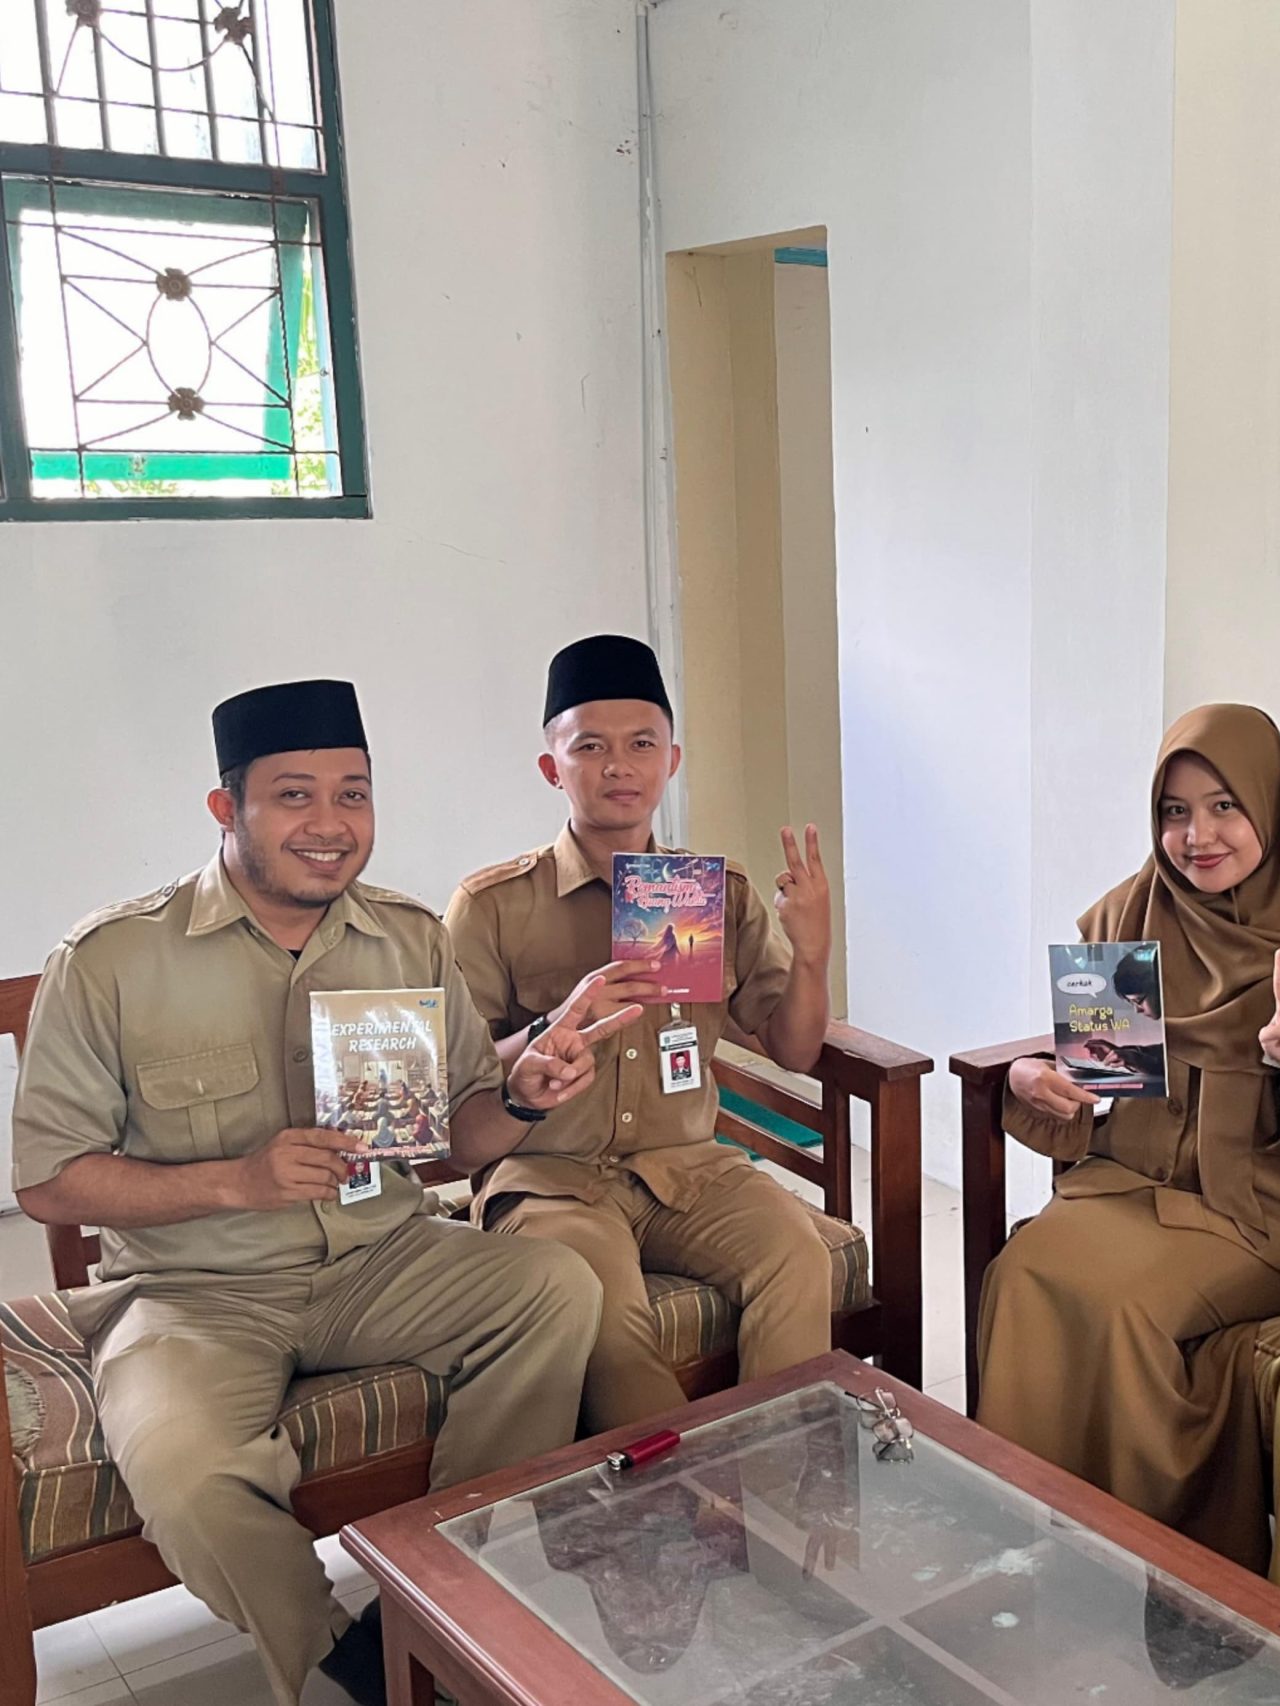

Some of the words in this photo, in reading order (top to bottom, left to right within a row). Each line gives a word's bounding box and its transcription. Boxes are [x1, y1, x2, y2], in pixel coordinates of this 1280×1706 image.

[1069, 1004, 1113, 1020] Amarga
[1069, 1020, 1108, 1033] Status
[1110, 1018, 1130, 1030] WA
[349, 1037, 417, 1053] RESEARCH
